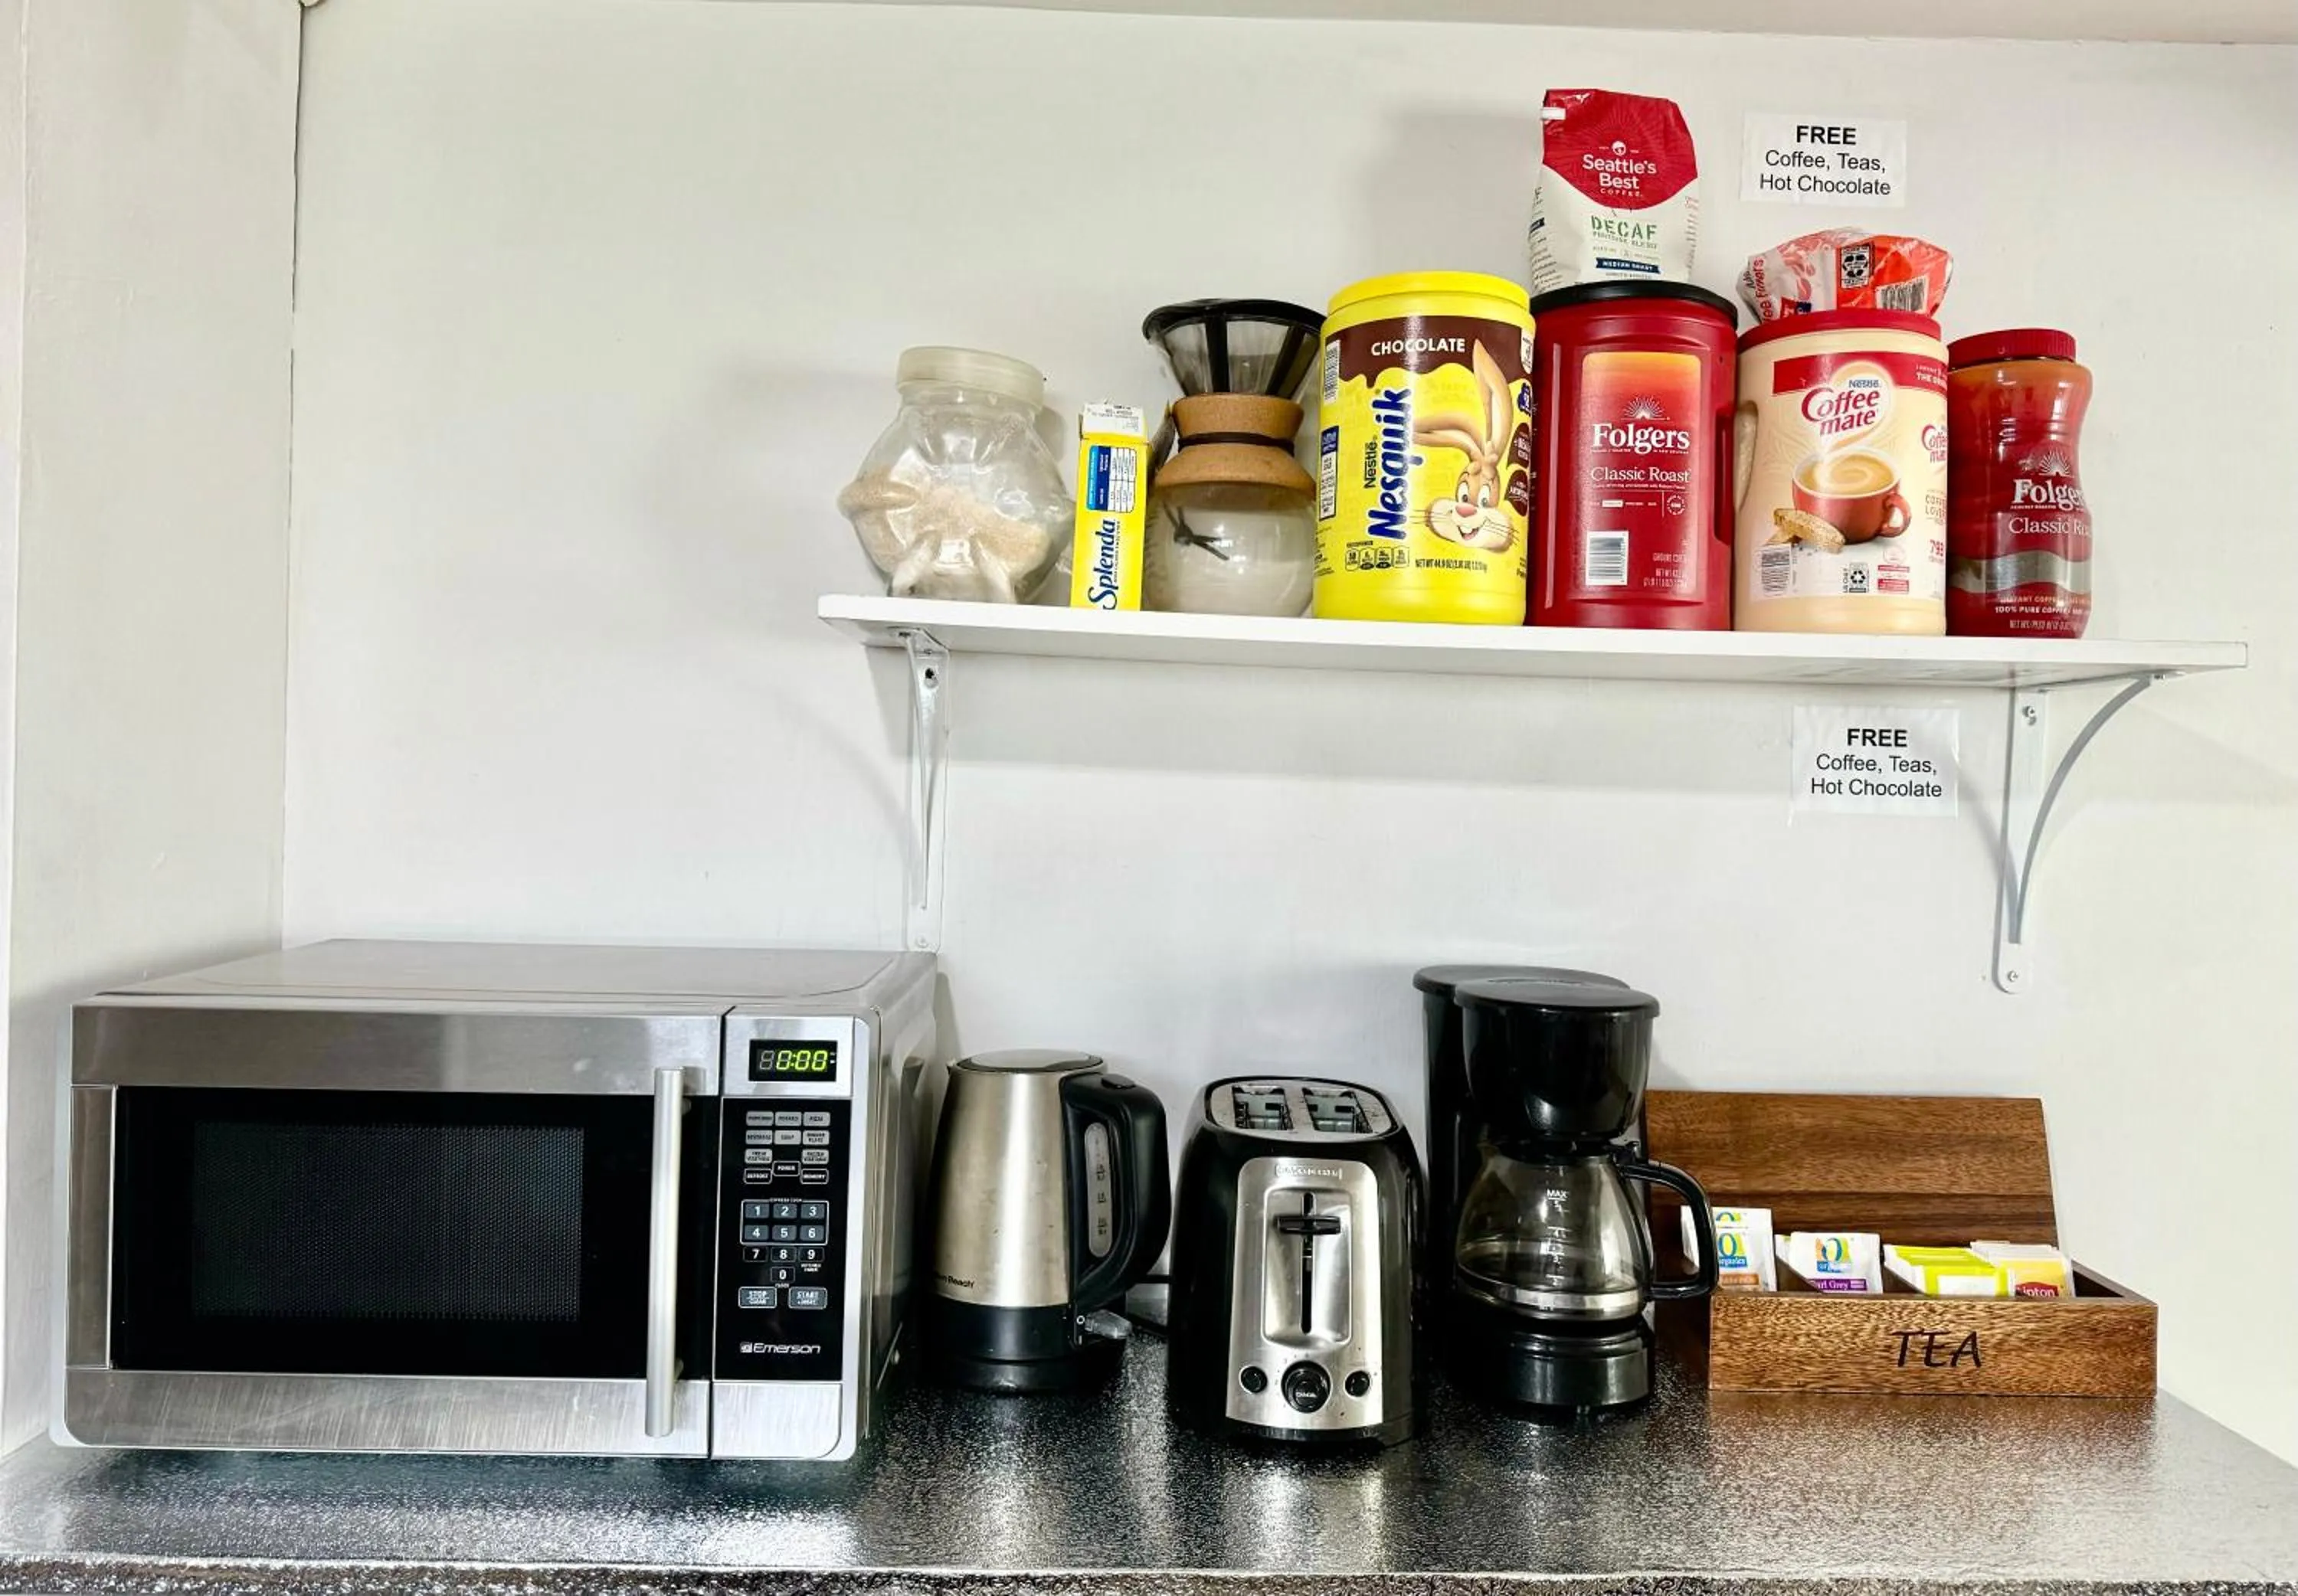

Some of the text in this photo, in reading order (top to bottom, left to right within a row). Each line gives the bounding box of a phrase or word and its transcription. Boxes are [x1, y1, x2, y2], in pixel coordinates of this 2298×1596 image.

[1796, 125, 1857, 146] FREE
[1583, 154, 1657, 175] Seattle's
[1765, 149, 1886, 174] Coffee, Teas,
[1599, 172, 1640, 190] Best
[1760, 173, 1891, 195] Hot Chocolate
[1591, 215, 1658, 240] DECAF
[1370, 338, 1466, 356] CHOCOLATE
[1801, 387, 1881, 422] Coffee
[1819, 408, 1877, 436] mate
[1593, 422, 1691, 454] Folgers
[1364, 439, 1378, 489] Nestlé
[1367, 388, 1425, 540] Nesquik
[1590, 466, 1690, 483] Classic Roast
[2008, 516, 2070, 535] Classic
[1087, 518, 1119, 610] Splenda
[1847, 728, 1908, 747] FREE
[1816, 754, 1937, 775] Coffee, Teas,
[1811, 777, 1943, 797] Hot Chocolate
[1547, 1189, 1567, 1199] MAX
[754, 1206, 761, 1216] 1
[781, 1206, 789, 1216] 2
[808, 1206, 817, 1217] 3
[751, 1228, 761, 1238] 4
[780, 1228, 788, 1238] 5
[807, 1228, 816, 1238] 6
[751, 1248, 760, 1259] 7
[779, 1249, 787, 1260] 8
[807, 1249, 816, 1260] 9
[778, 1269, 787, 1280] 0
[1828, 1280, 1849, 1290] Grey
[2016, 1285, 2056, 1297] ipton
[753, 1343, 821, 1354] Emerson
[1890, 1328, 1982, 1369] TEA
